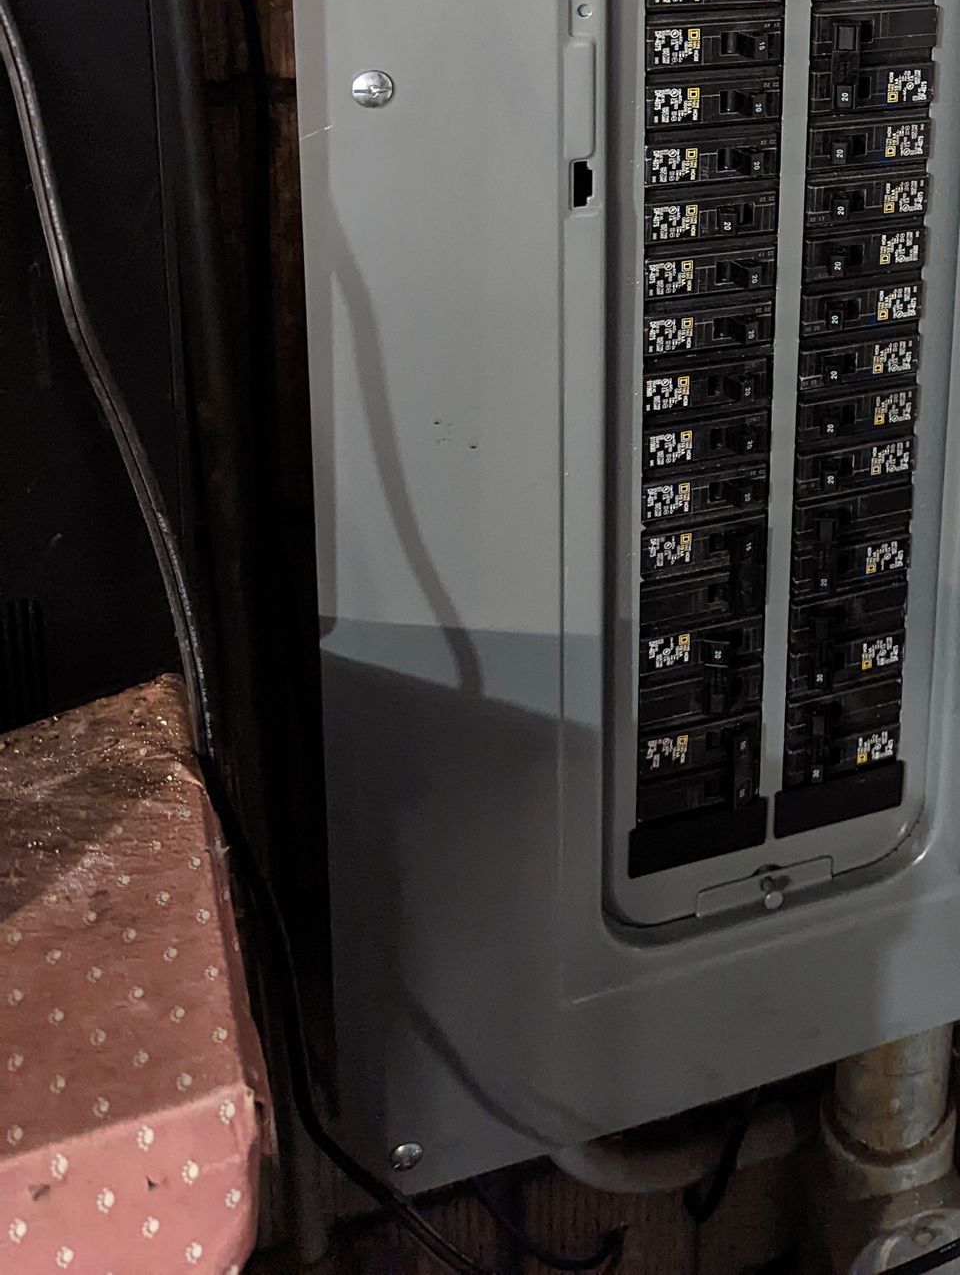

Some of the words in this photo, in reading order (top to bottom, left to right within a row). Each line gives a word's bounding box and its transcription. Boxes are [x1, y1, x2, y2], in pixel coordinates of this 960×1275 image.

[758, 40, 766, 51] 15
[841, 92, 849, 102] 20
[754, 103, 763, 113] 20
[836, 148, 844, 159] 20
[753, 161, 761, 171] 20
[837, 206, 845, 216] 20
[723, 221, 732, 231] 20
[834, 261, 841, 271] 20
[751, 274, 758, 284] 20
[831, 315, 839, 325] 20
[748, 329, 755, 340] 20
[831, 370, 838, 380] 20
[827, 423, 835, 434] 20
[827, 475, 835, 485] 20
